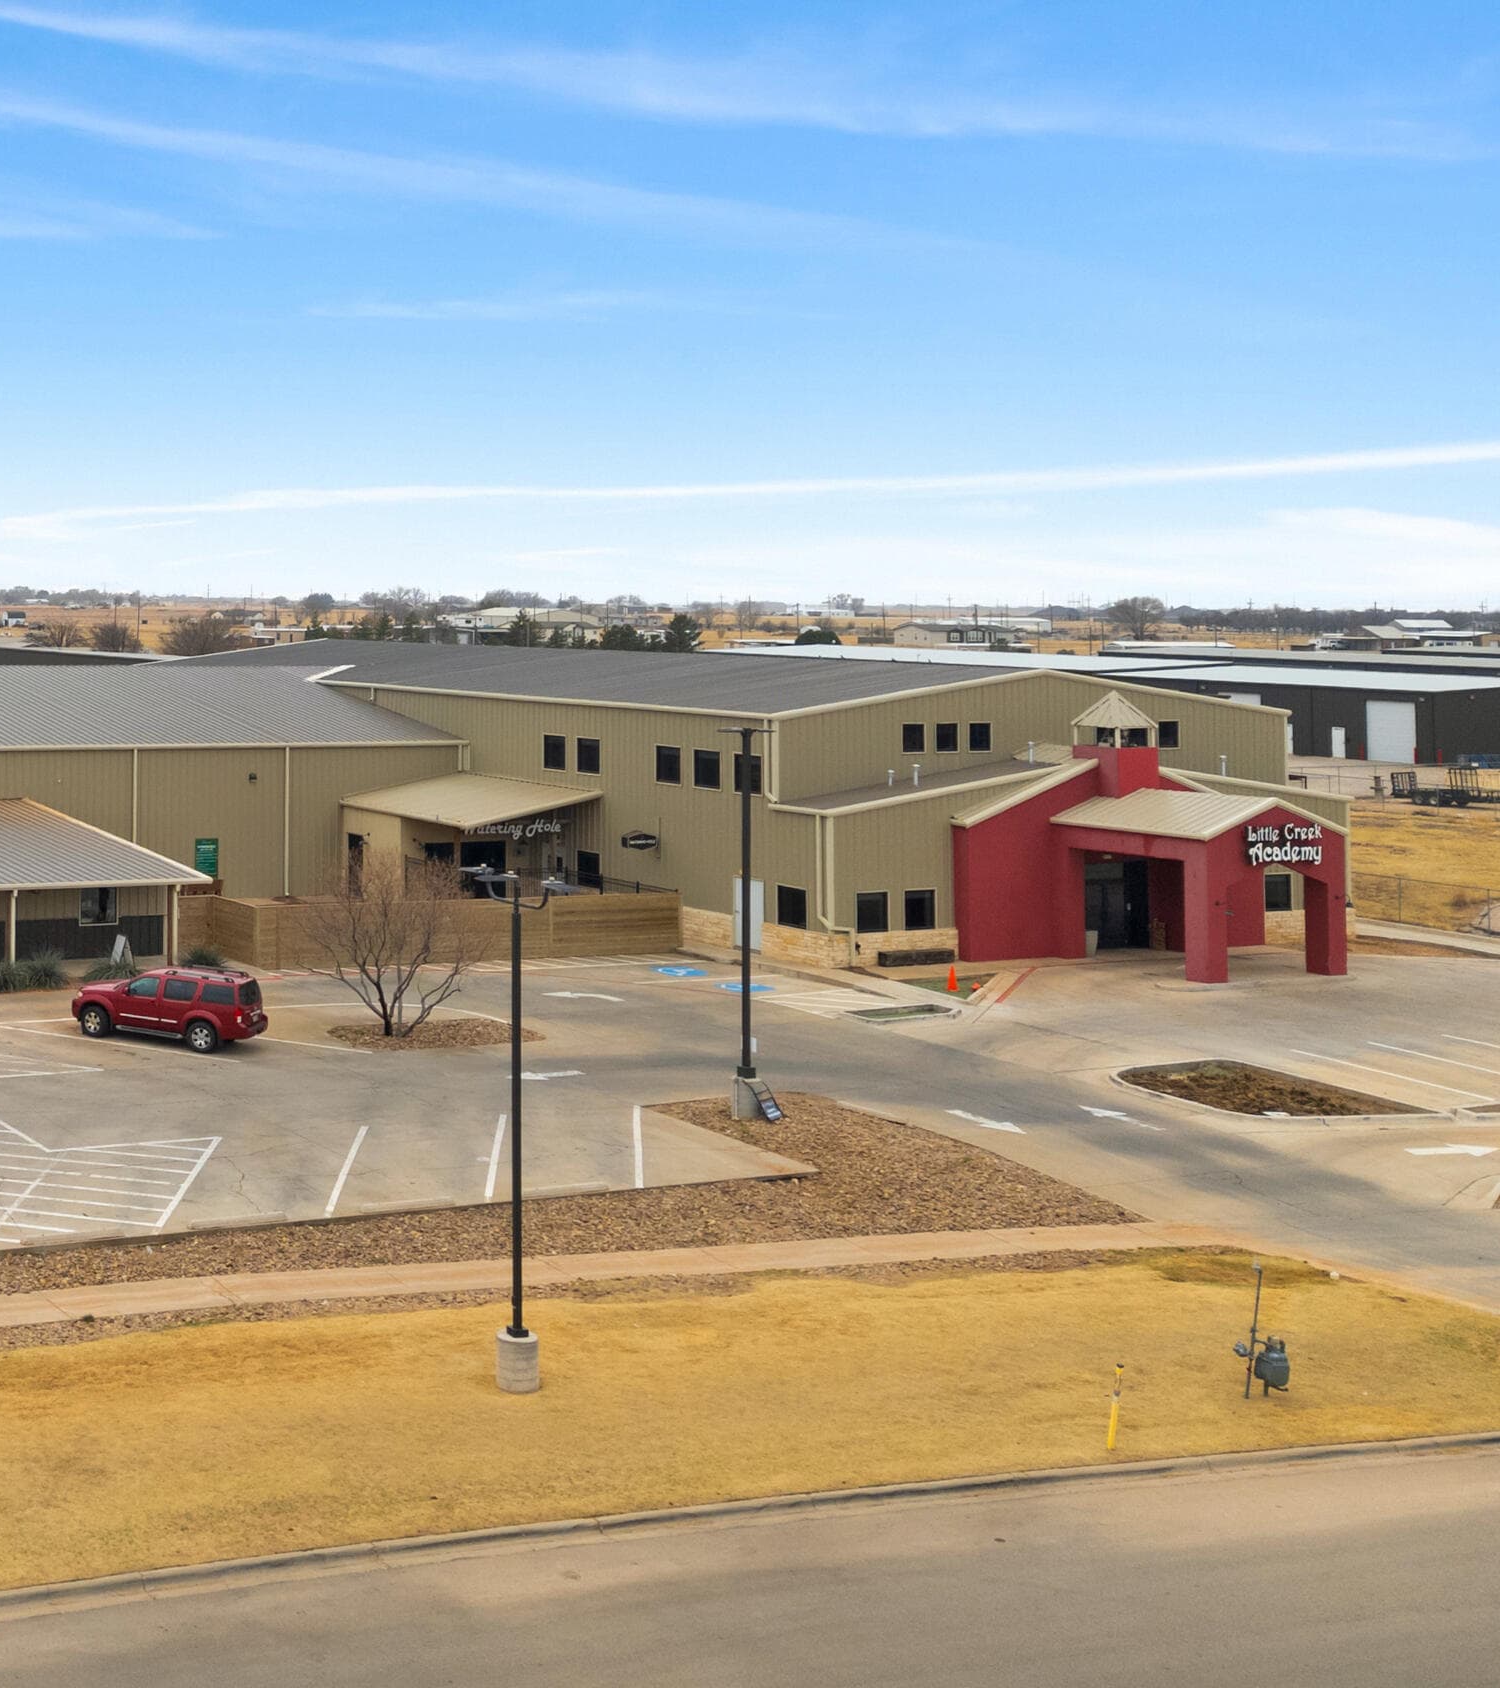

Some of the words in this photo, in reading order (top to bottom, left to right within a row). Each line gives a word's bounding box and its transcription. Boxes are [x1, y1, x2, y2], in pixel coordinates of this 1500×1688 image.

[525, 818, 561, 837] Hole
[1247, 826, 1280, 842] Little
[1284, 823, 1322, 840] Creek
[1248, 841, 1322, 866] Academy
